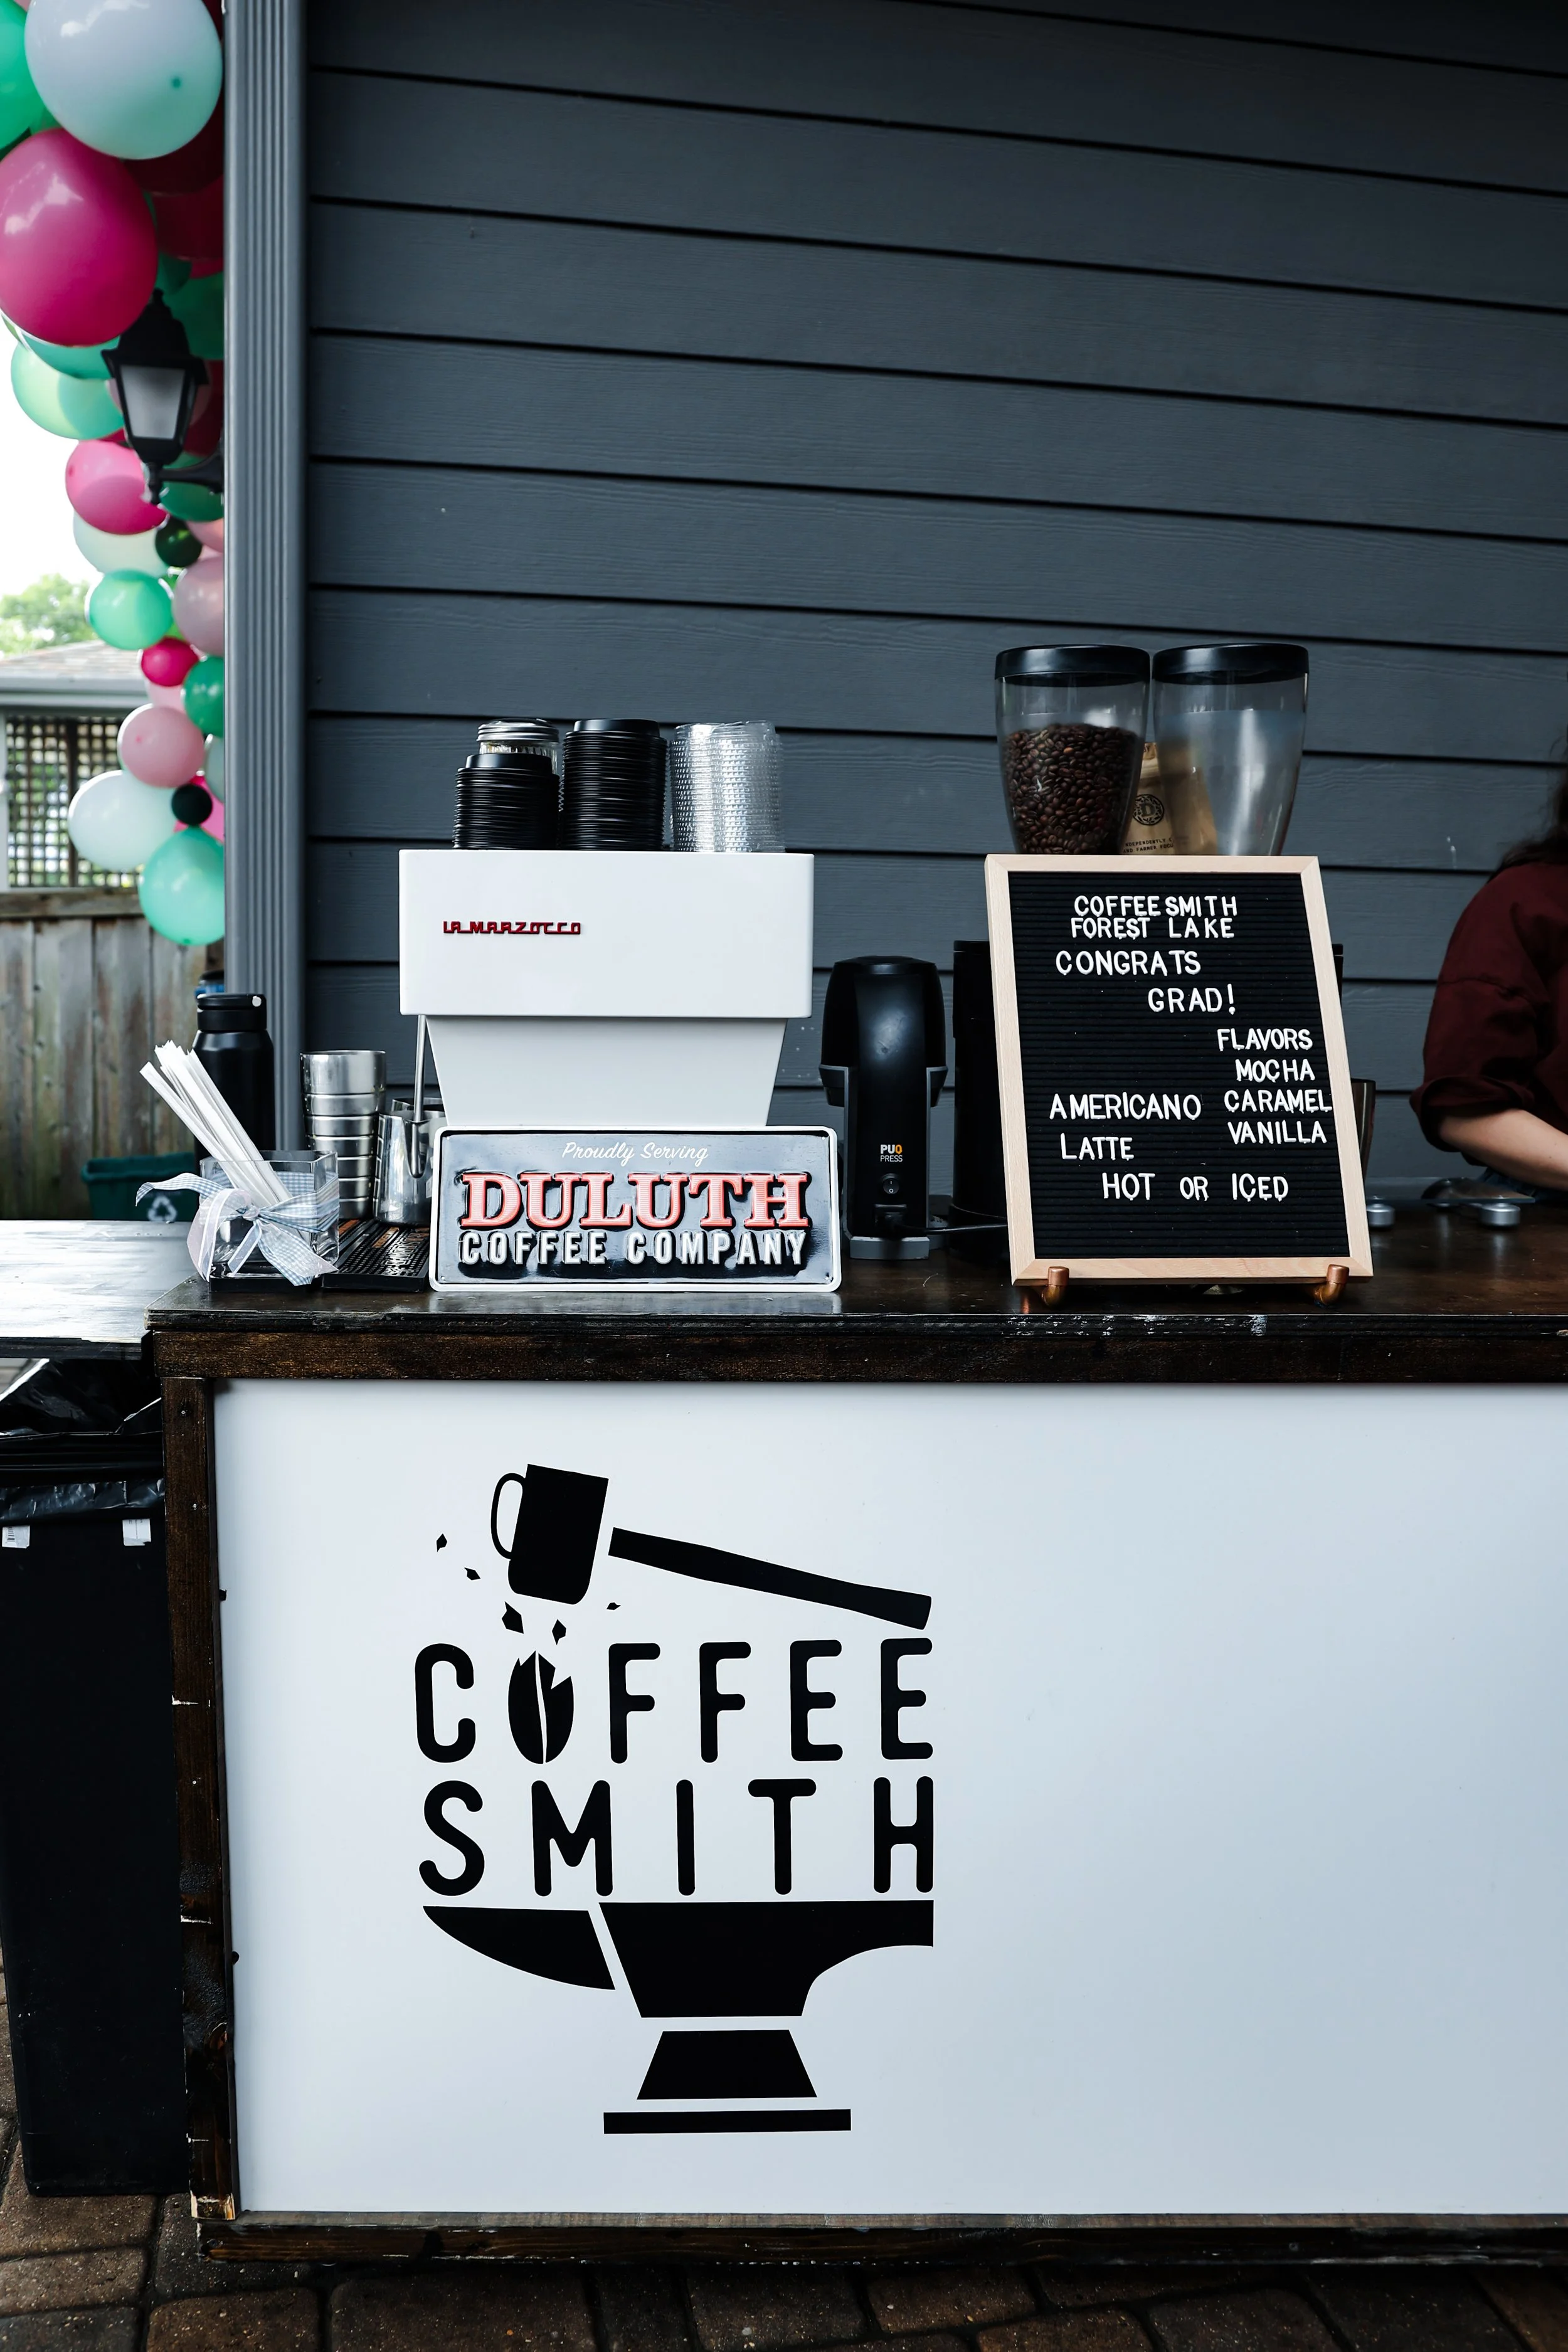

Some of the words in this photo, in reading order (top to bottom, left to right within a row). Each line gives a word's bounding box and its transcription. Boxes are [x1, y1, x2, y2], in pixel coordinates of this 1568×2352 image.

[1074, 896, 1161, 916] COFFEE
[1165, 896, 1237, 917] SMITH
[443, 921, 461, 933] LA
[1071, 918, 1151, 940] FOREST
[1168, 917, 1234, 938] LAKE
[1056, 950, 1201, 976] CONGRATS
[1148, 983, 1236, 1015] GRAD!
[1217, 1029, 1313, 1051] FLAVORS
[1236, 1059, 1315, 1083] MOCHA
[1049, 1092, 1201, 1120] AMERICANO
[1224, 1089, 1332, 1113] CARAMEL
[1227, 1120, 1327, 1145] VANILLA
[561, 1142, 635, 1168] Proudly
[640, 1142, 709, 1167] Serving
[1061, 1133, 1134, 1160] LATTE
[458, 1172, 810, 1227] DULUTH
[1102, 1172, 1156, 1200] HOT
[1180, 1176, 1209, 1201] OR
[1232, 1173, 1289, 1202] ICED
[460, 1231, 607, 1266] COFFEE
[627, 1231, 807, 1266] COMPANY
[415, 1637, 933, 1764] COFFEE
[419, 1776, 933, 1897] SMITH
